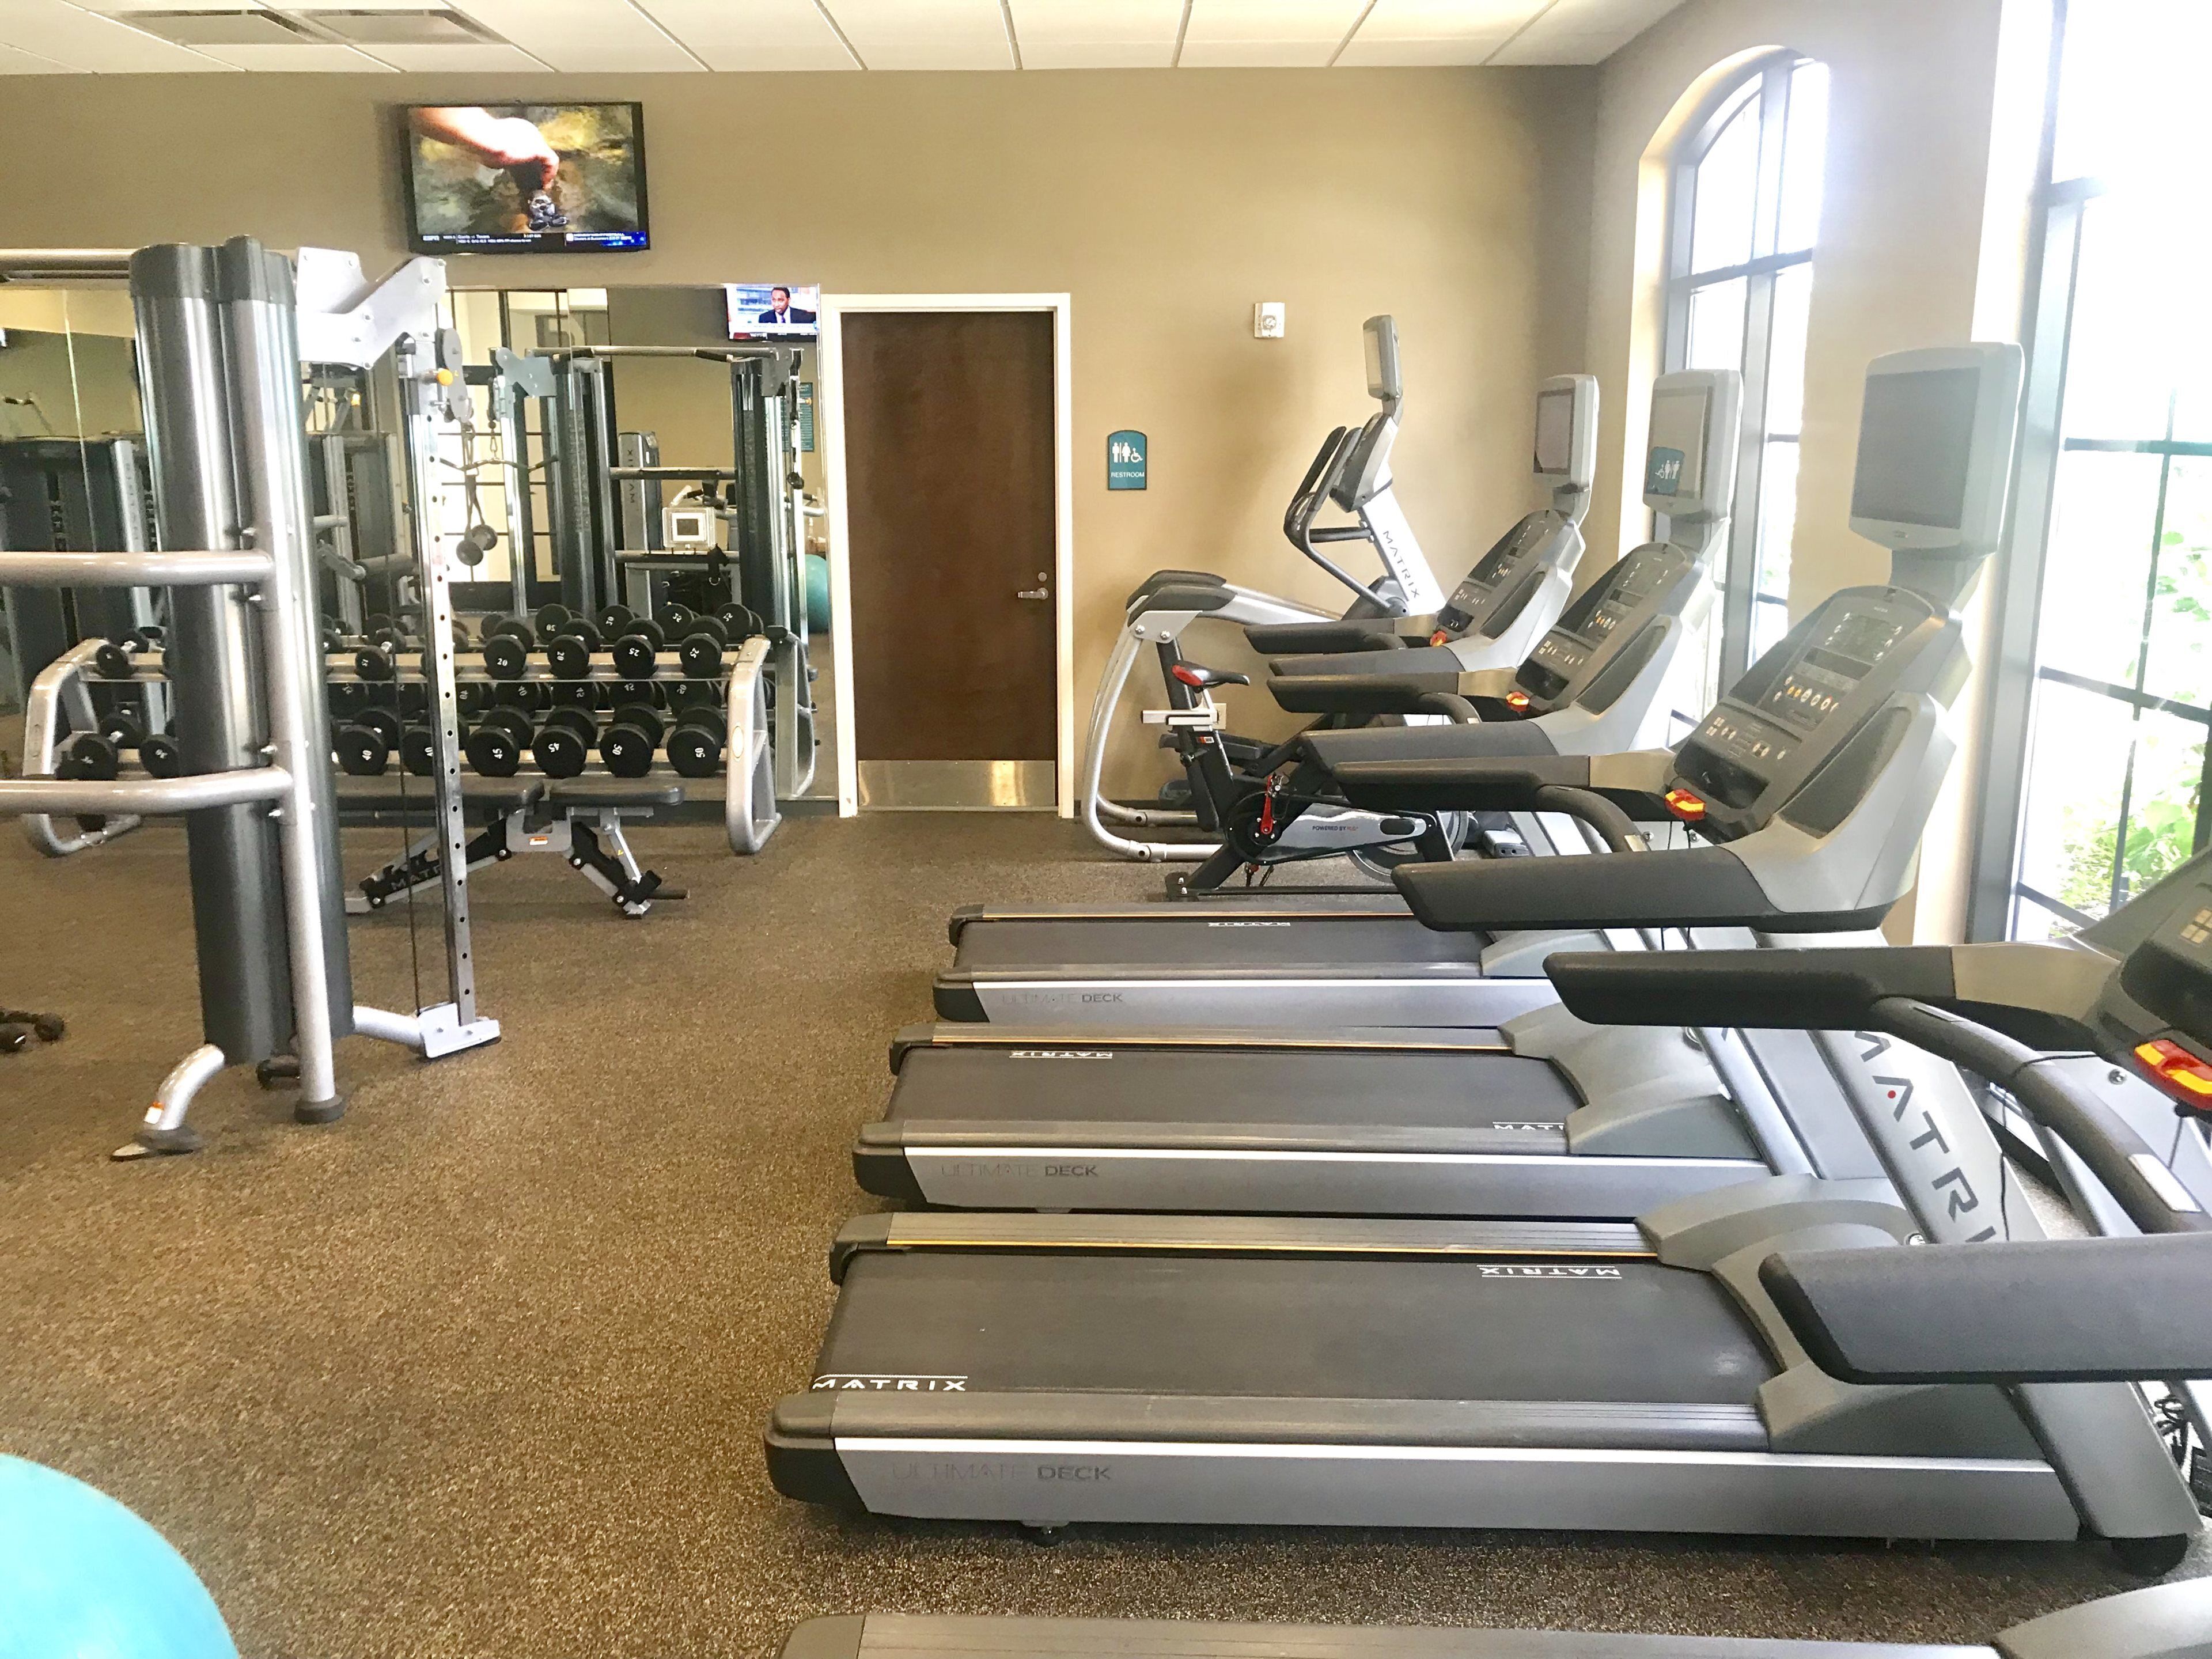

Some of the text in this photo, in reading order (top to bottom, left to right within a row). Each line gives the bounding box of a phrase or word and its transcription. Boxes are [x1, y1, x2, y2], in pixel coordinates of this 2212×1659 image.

[1382, 530, 1420, 599] MATRIX
[556, 651, 565, 661] 20
[628, 647, 639, 657] 25
[689, 647, 700, 658] 25
[497, 658, 508, 666] 20
[548, 742, 559, 752] 45
[612, 744, 623, 755] 50
[695, 747, 705, 758] 50
[362, 749, 372, 760] 40
[492, 748, 503, 759] 45
[1082, 994, 1123, 1002] DECK
[1854, 1030, 1997, 1243] MATRI
[1045, 1165, 1098, 1176] DECK
[1479, 1267, 1620, 1276] MATRIX
[812, 1378, 966, 1391] MATRIX
[1037, 1466, 1111, 1480] DECK
